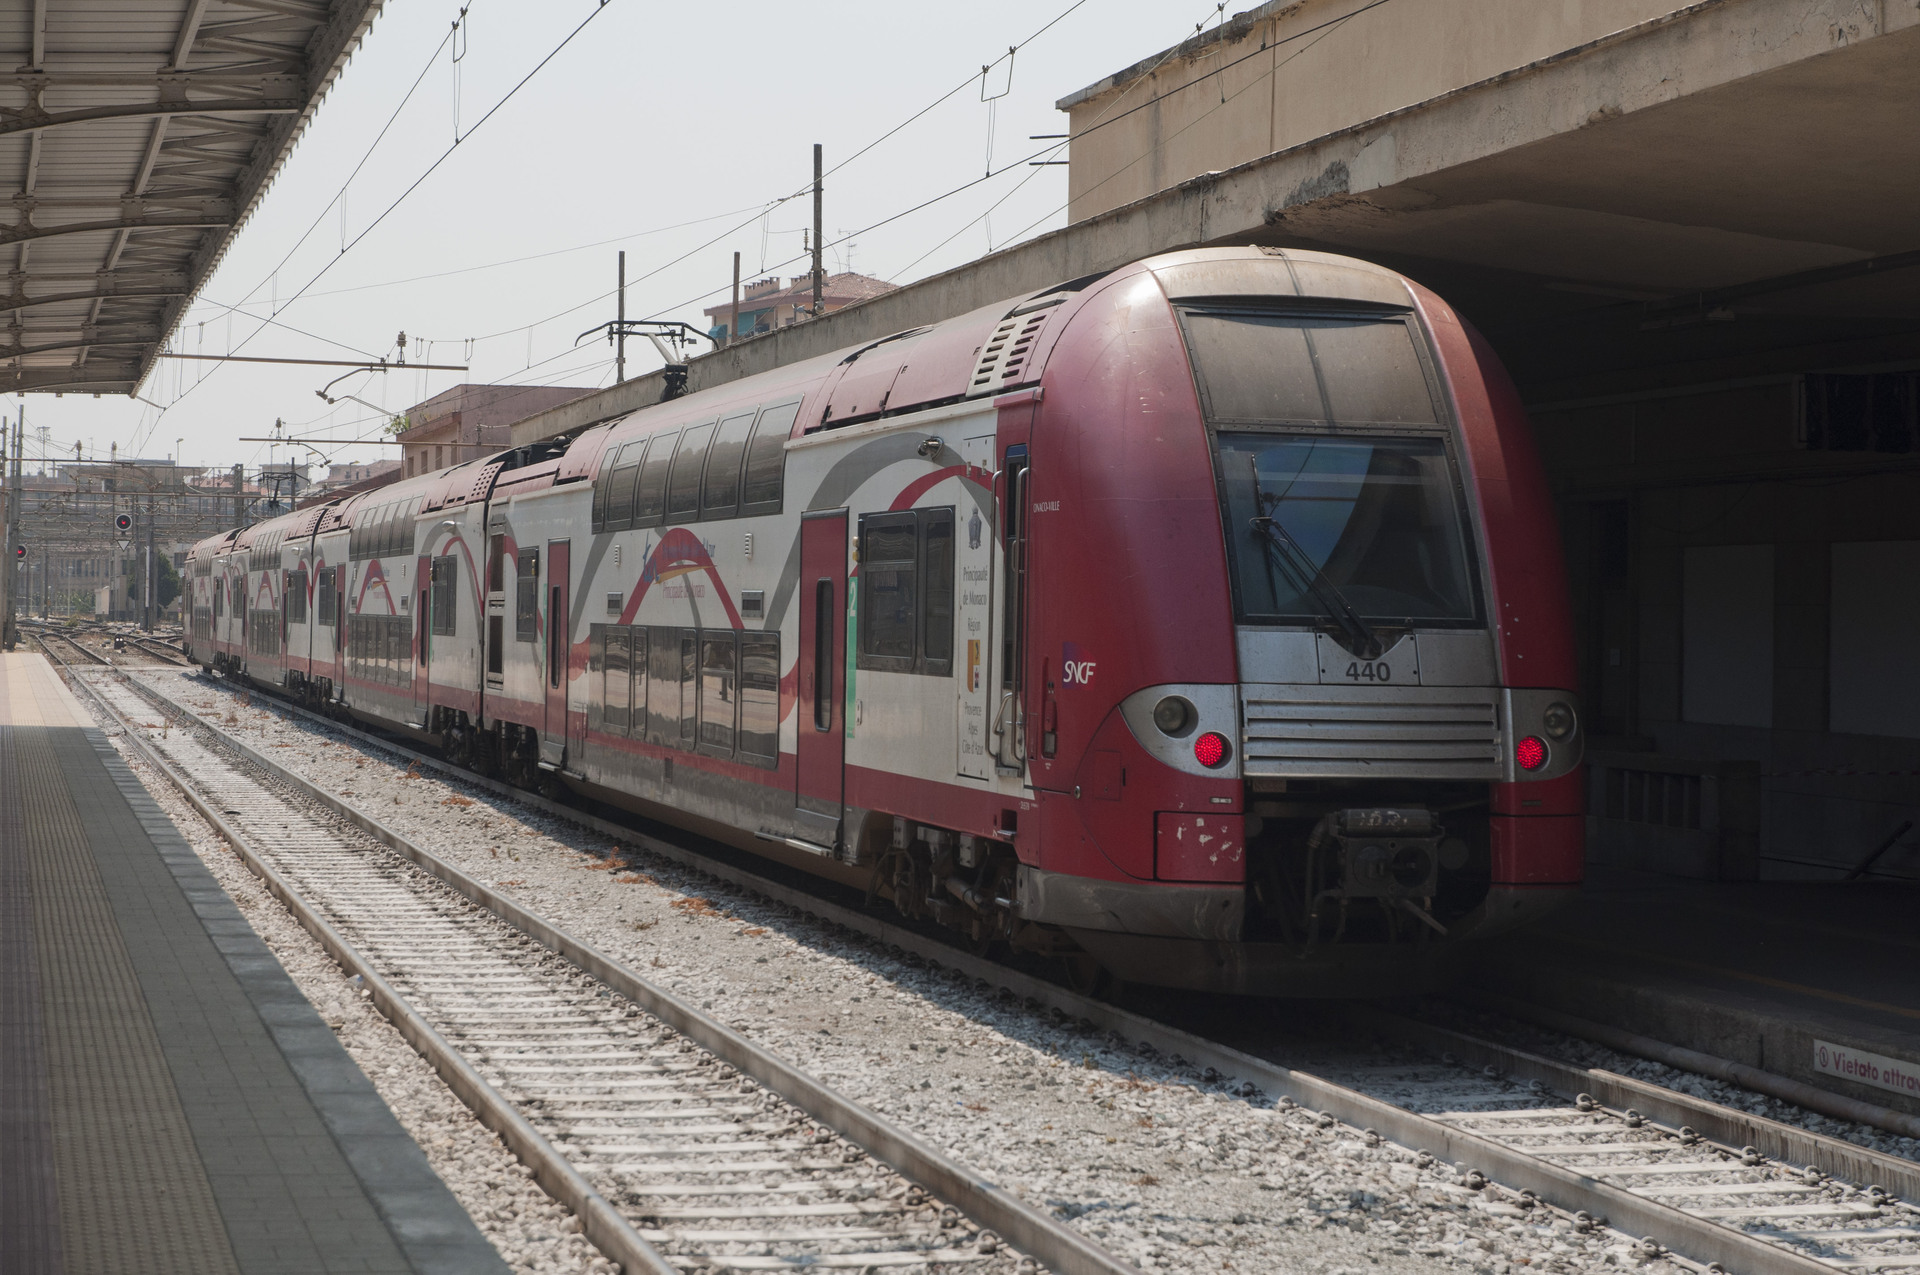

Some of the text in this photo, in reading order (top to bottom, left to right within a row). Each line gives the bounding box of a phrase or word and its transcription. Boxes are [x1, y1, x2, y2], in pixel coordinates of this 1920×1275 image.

[850, 581, 856, 616] 2
[1063, 660, 1096, 684] SNCF
[1346, 662, 1391, 682] 440
[1833, 1051, 1878, 1080] Vietato
